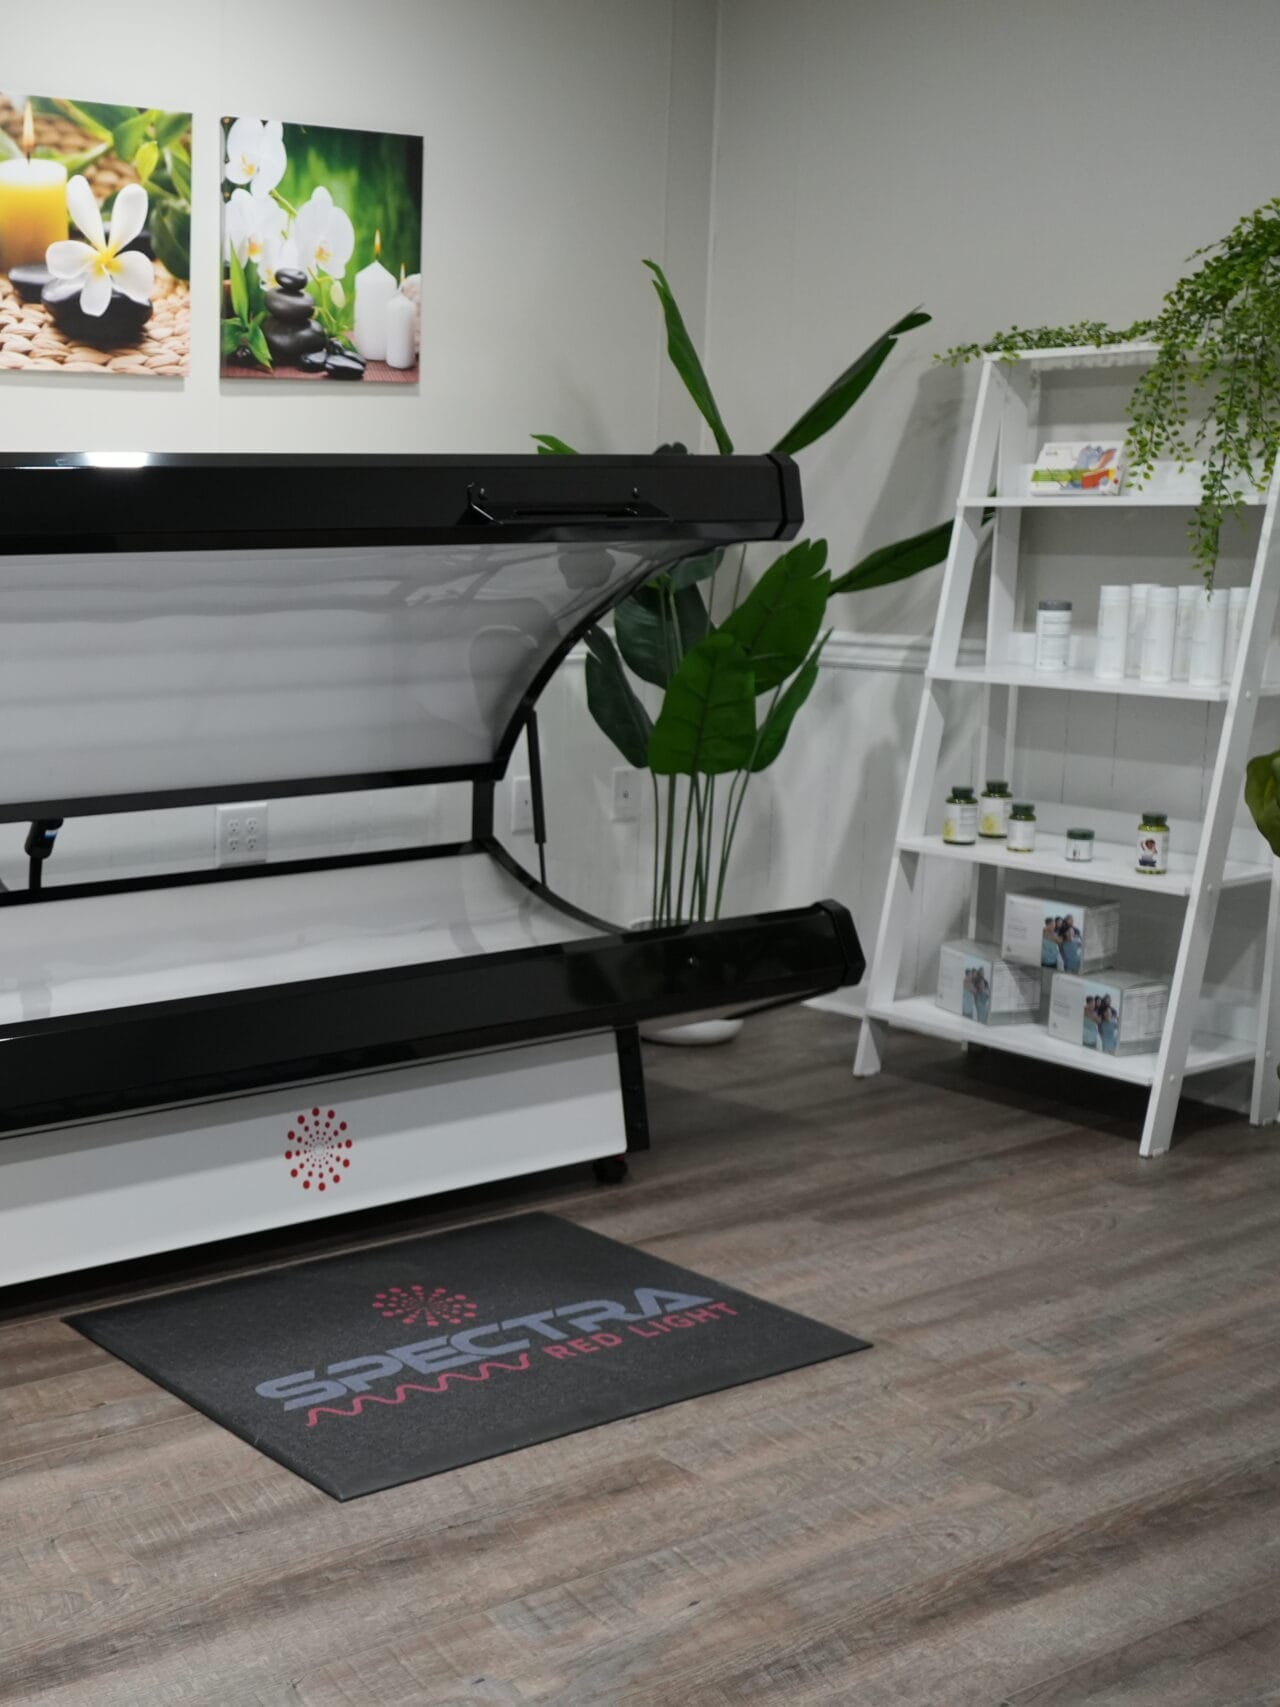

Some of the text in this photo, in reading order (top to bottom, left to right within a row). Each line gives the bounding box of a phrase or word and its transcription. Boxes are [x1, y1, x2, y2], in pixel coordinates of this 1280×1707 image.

[255, 1287, 715, 1411] SPECTRA
[541, 1301, 738, 1360] RED LIGHT
